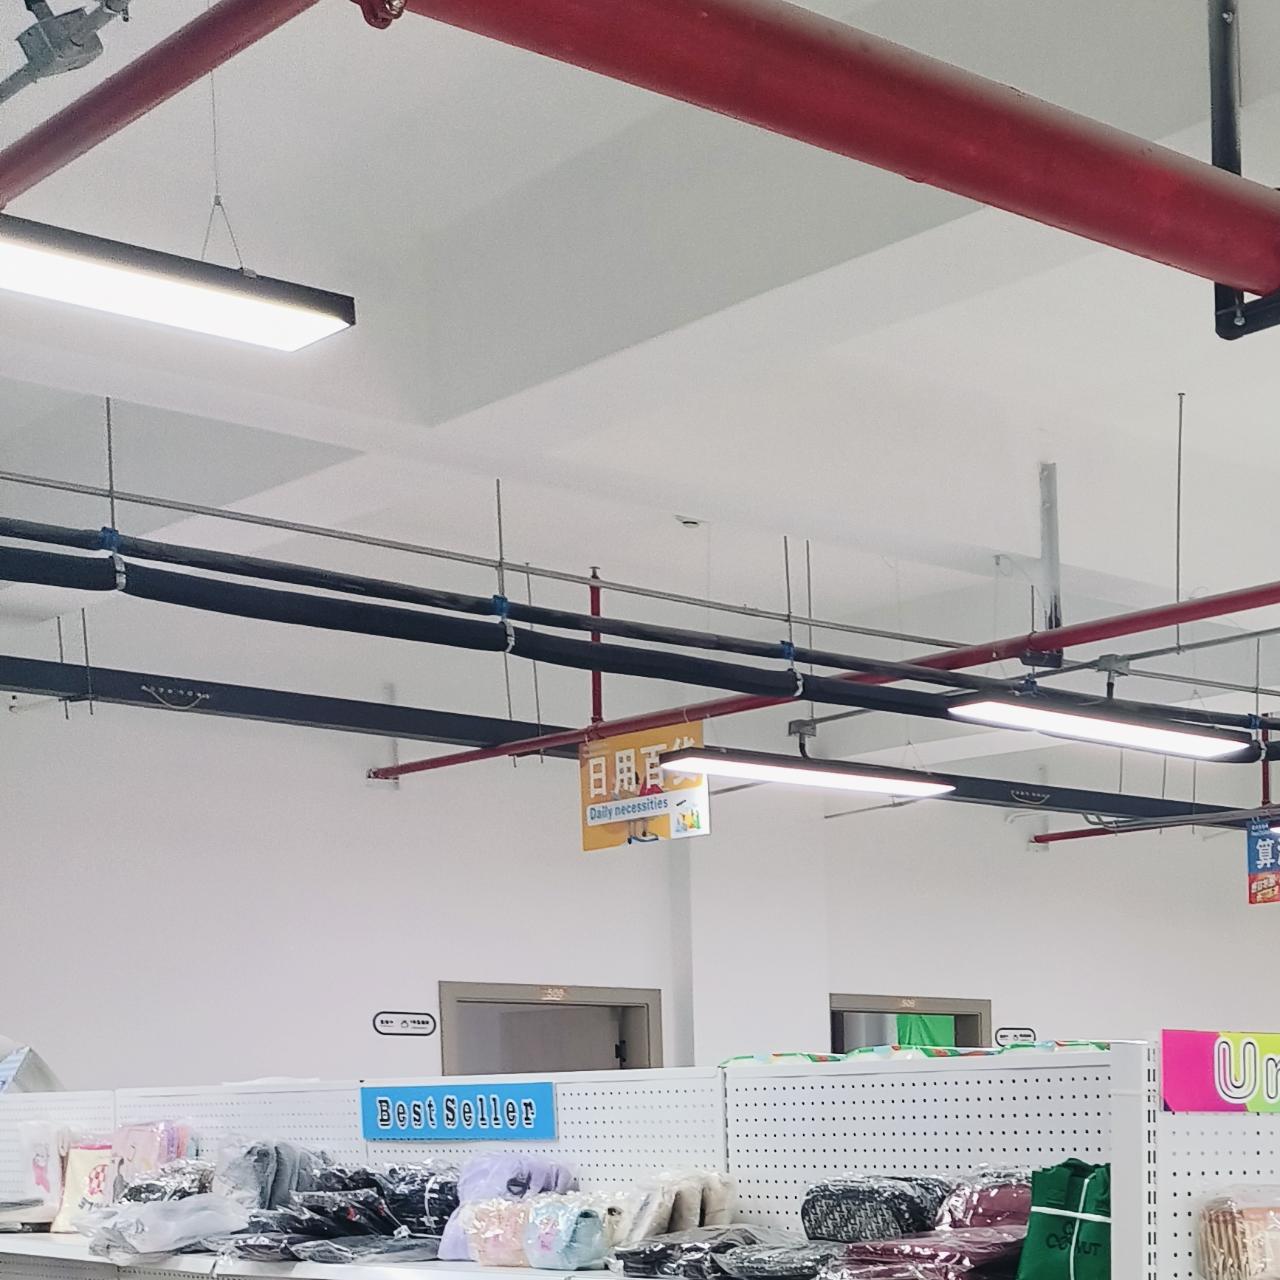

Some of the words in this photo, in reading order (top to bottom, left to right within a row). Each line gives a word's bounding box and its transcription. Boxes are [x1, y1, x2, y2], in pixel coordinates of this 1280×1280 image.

[589, 803, 613, 821] Daily
[614, 797, 669, 816] necessities
[377, 1097, 437, 1129] Best
[442, 1094, 537, 1129] Seller
